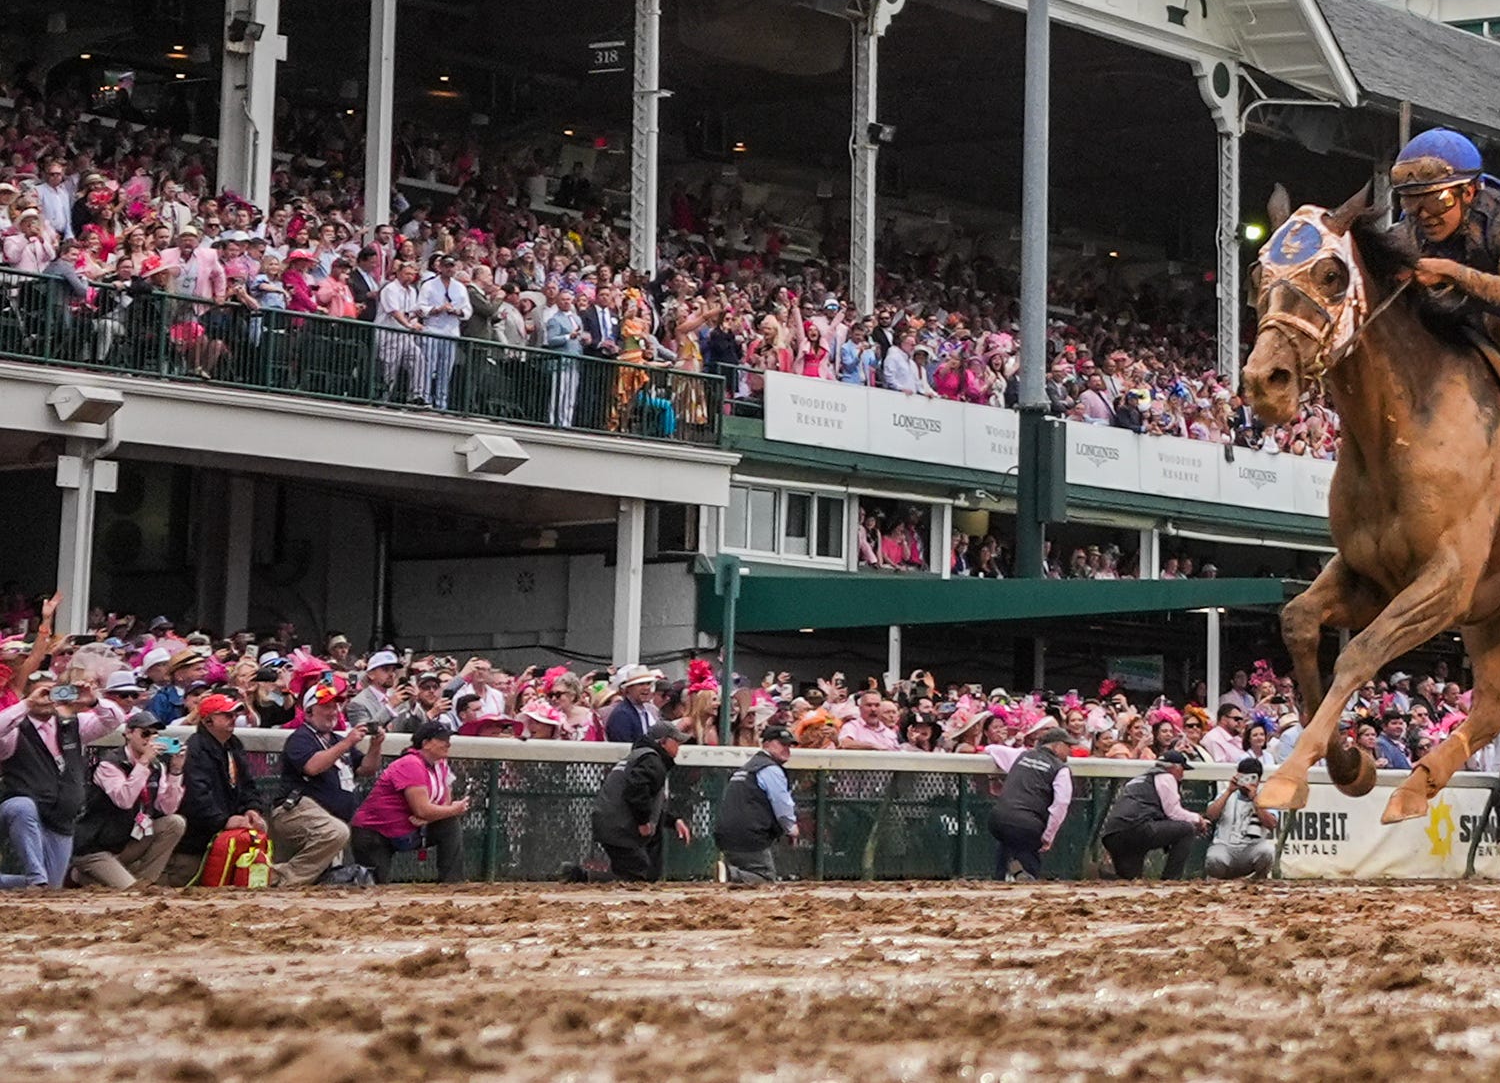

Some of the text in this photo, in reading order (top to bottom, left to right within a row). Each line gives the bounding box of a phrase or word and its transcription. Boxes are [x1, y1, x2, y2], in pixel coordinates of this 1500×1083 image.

[594, 50, 618, 64] 318
[790, 393, 848, 414] WOODFORD
[796, 412, 844, 430] RESERVE
[893, 412, 942, 434] LONGINES
[1076, 442, 1120, 461] LONGINES
[1278, 843, 1338, 855] ENTALS
